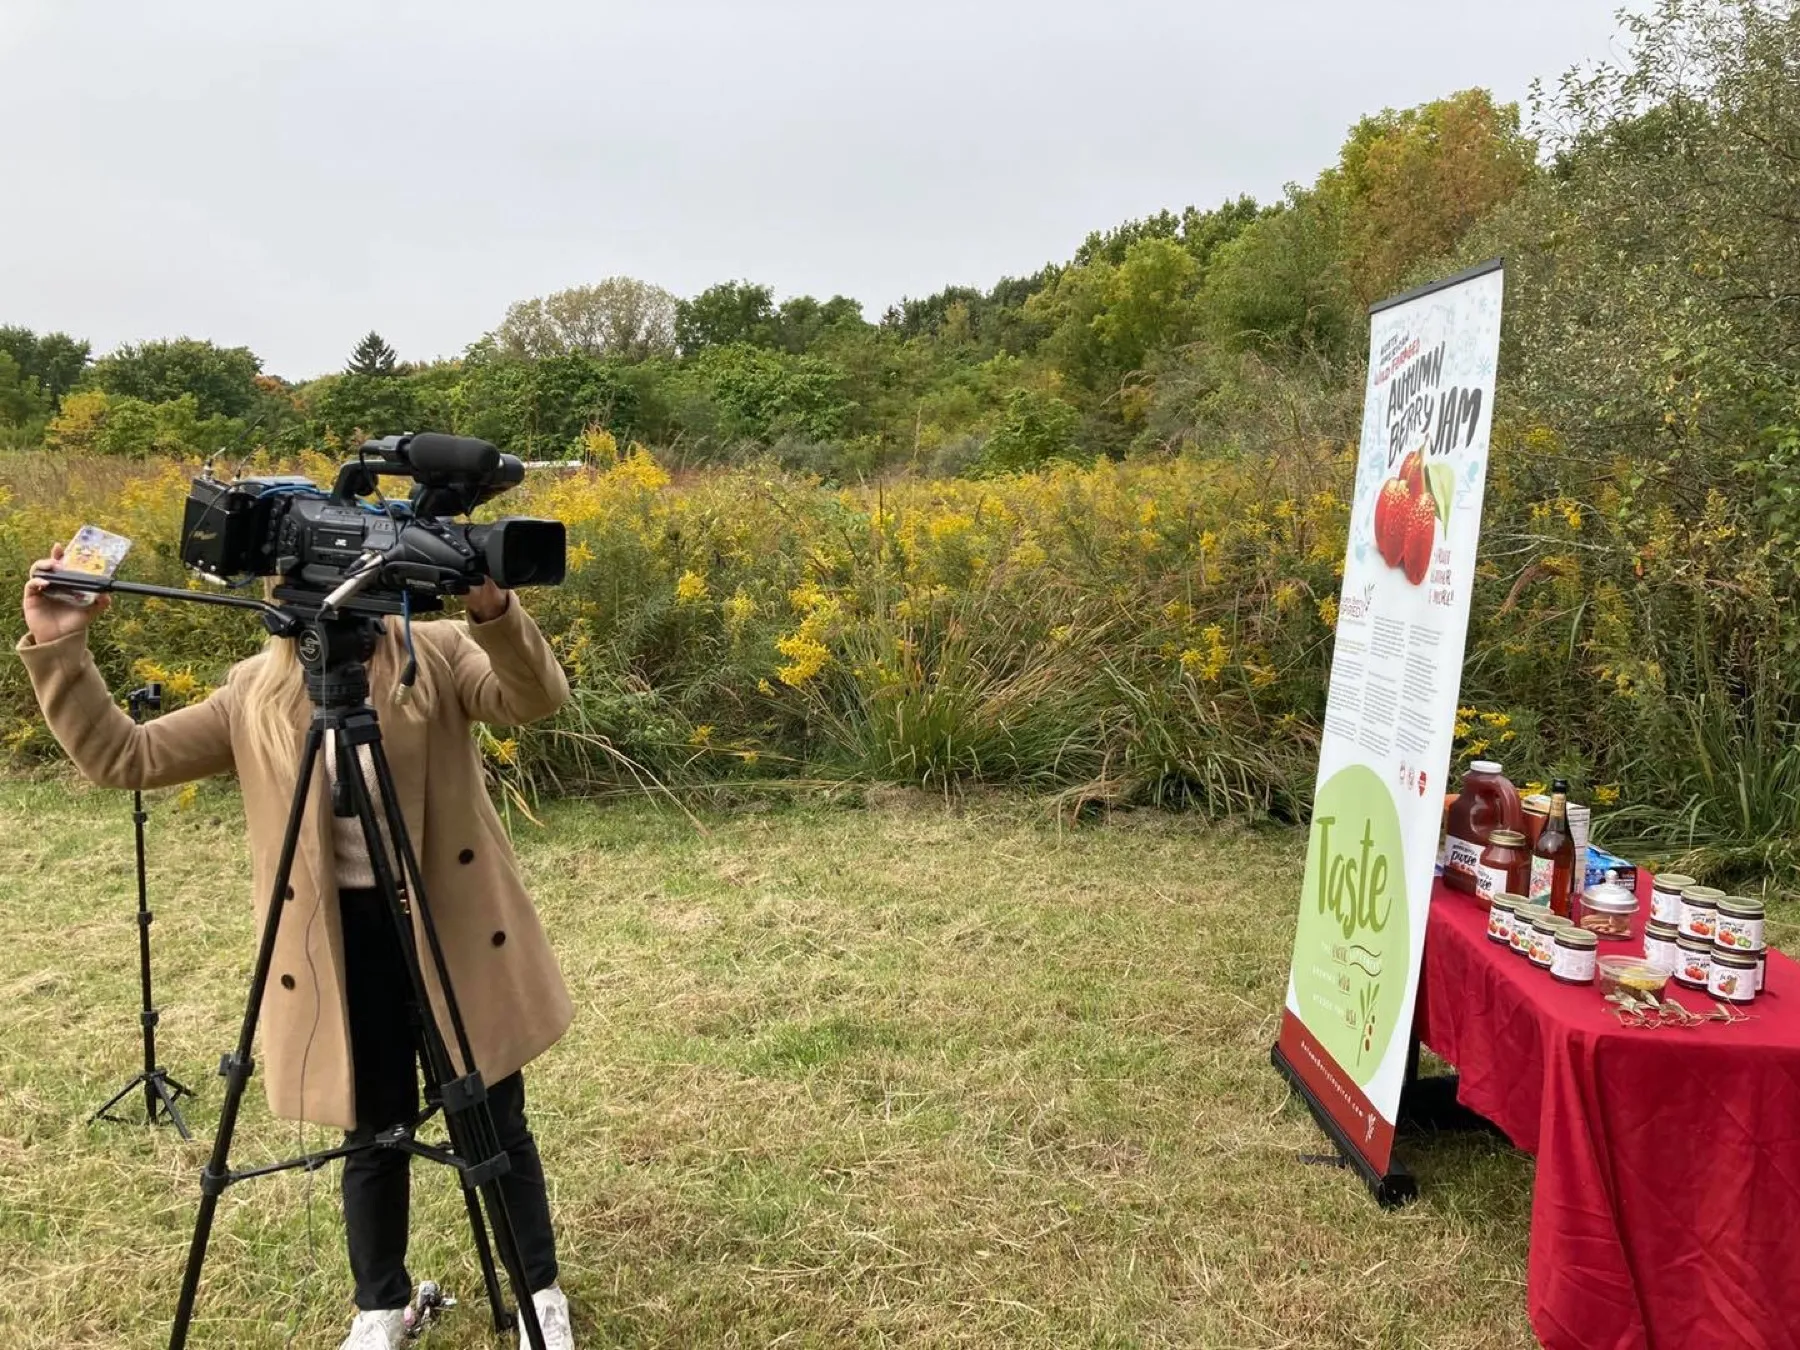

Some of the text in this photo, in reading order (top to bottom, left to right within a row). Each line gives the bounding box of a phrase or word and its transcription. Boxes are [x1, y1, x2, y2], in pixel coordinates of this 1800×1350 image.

[1386, 341, 1446, 429] AUTUMN
[1429, 386, 1482, 456] JAM
[1387, 393, 1435, 469] BERRY
[1315, 816, 1392, 940] Taste
